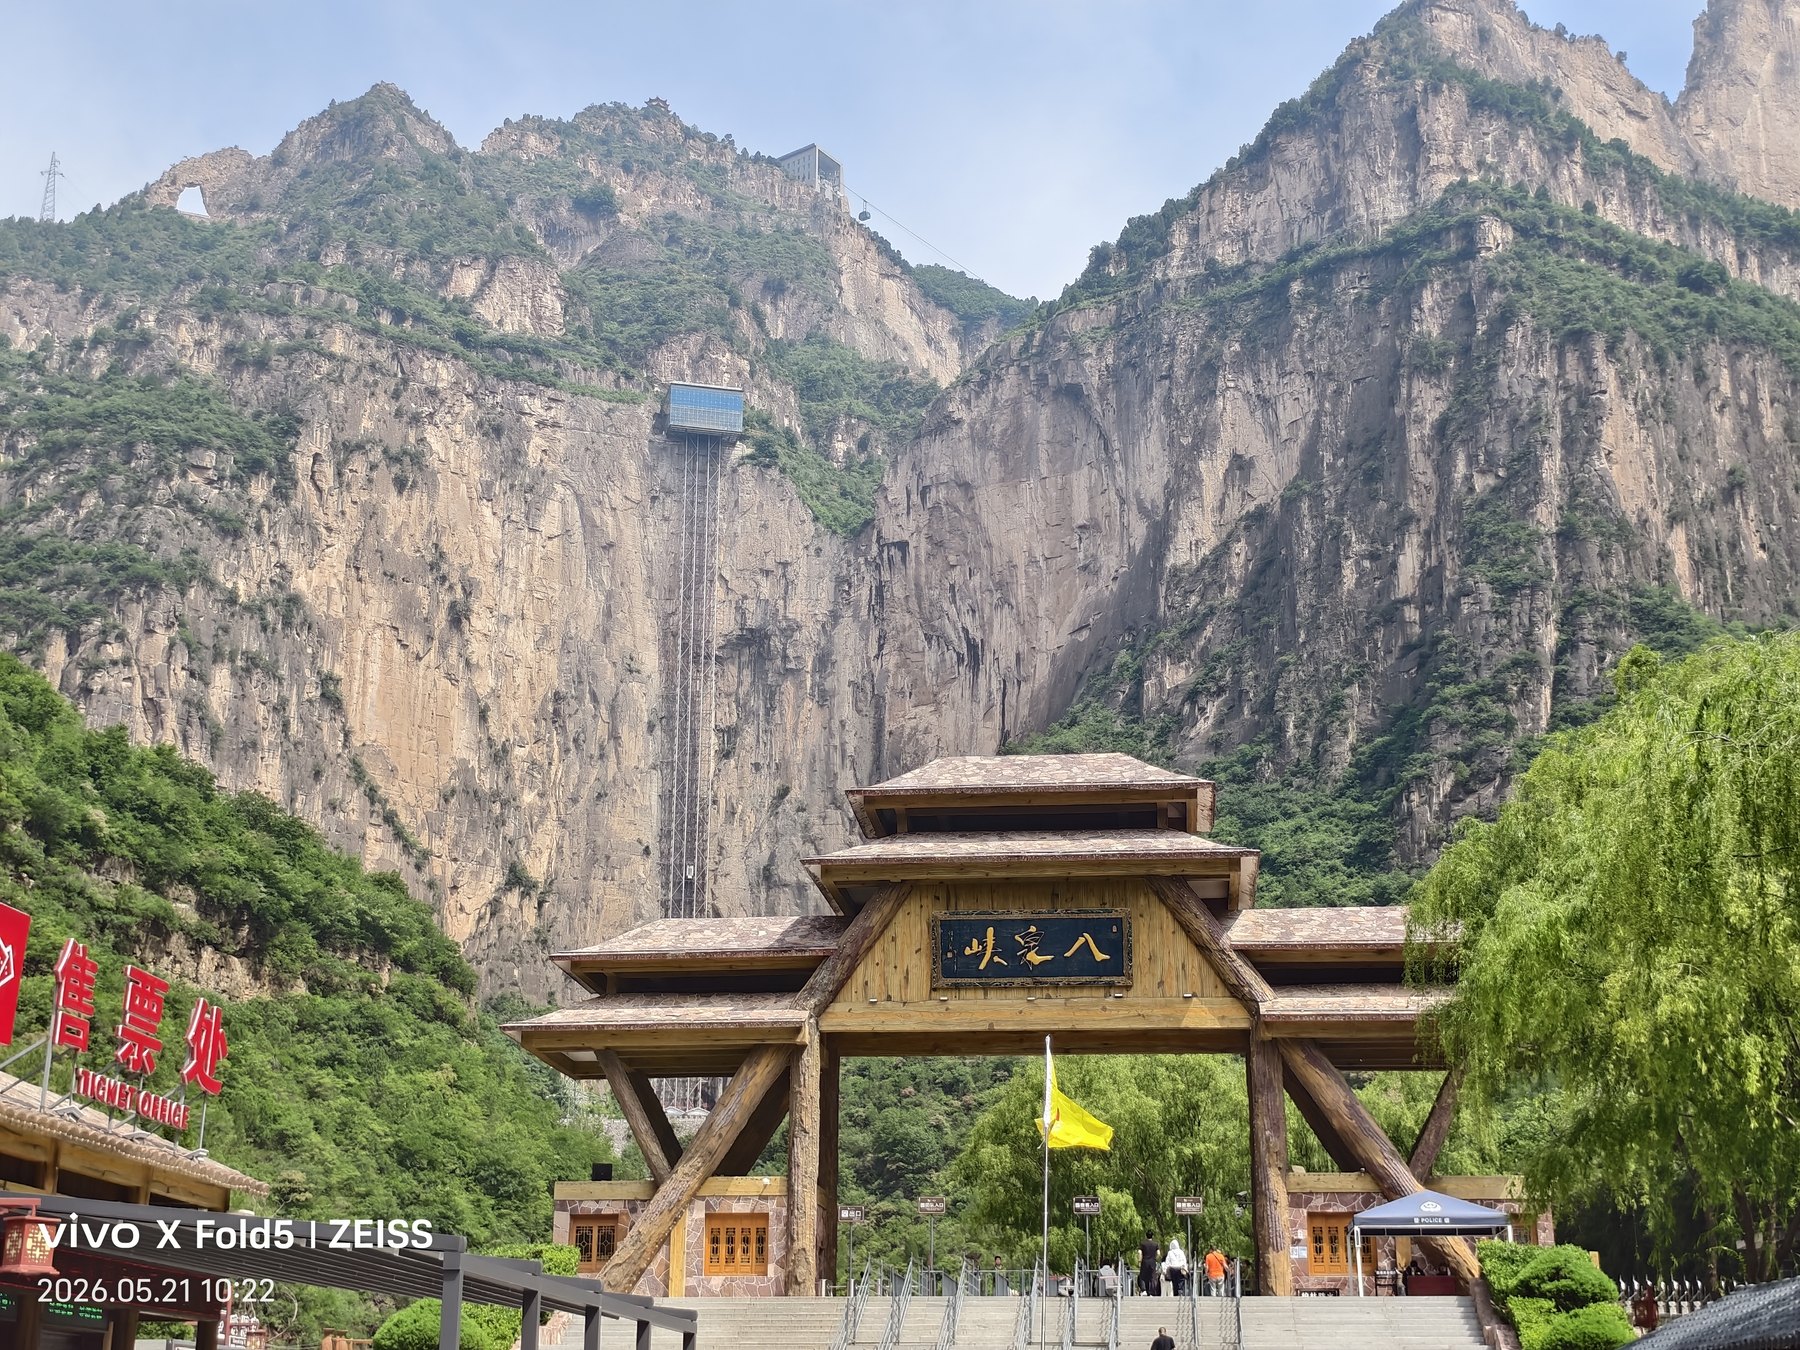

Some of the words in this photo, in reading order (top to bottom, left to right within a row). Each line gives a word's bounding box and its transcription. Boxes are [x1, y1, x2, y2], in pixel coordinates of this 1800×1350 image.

[54, 938, 228, 1095] 售票处
[76, 1068, 138, 1110] TICKET
[136, 1090, 190, 1130] OFFICE
